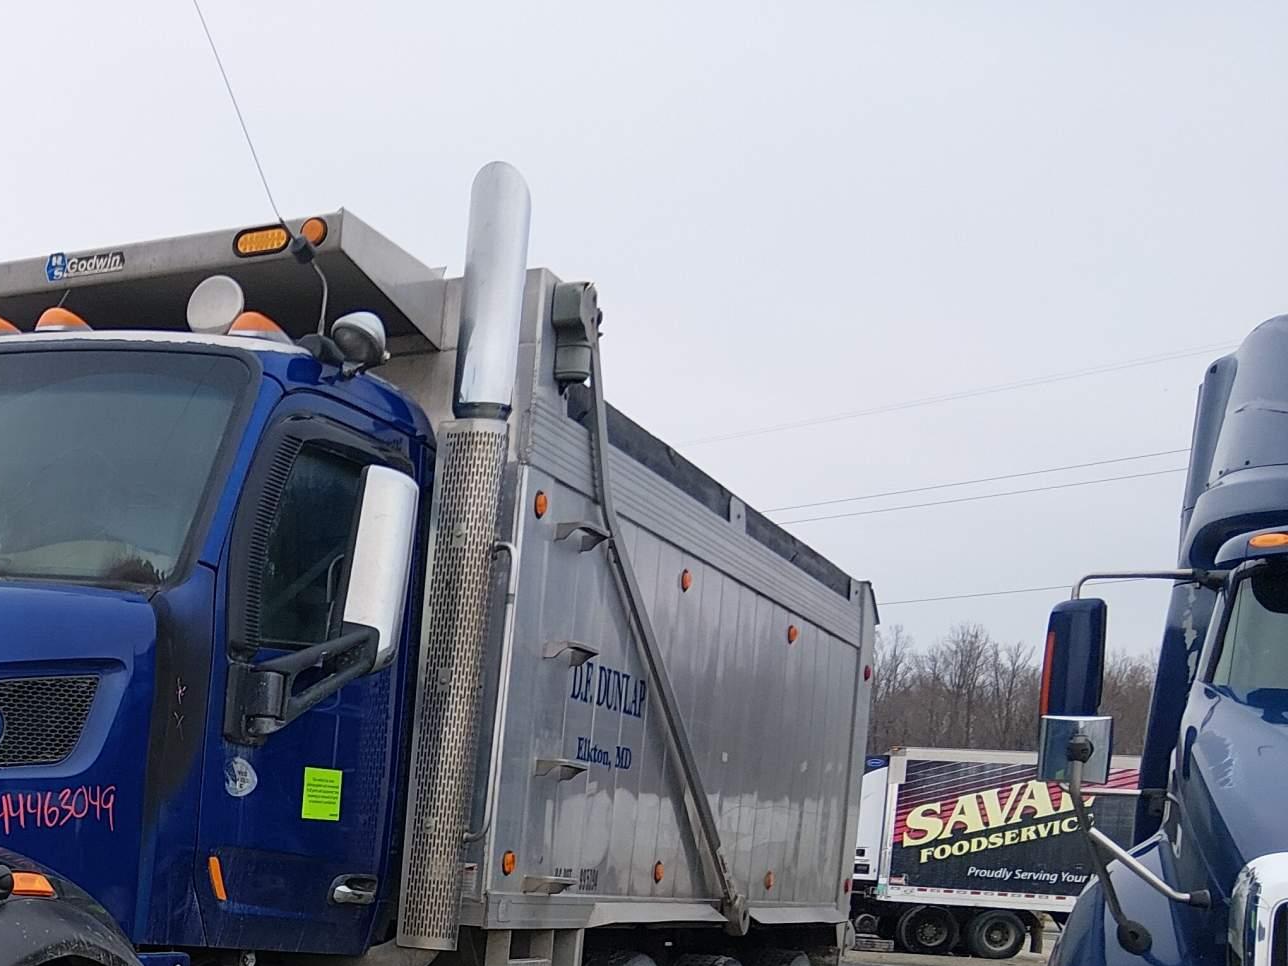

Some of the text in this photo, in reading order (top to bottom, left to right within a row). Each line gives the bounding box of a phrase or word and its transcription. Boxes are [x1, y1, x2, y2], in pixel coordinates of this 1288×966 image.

[67, 252, 121, 273] Godwin
[596, 665, 646, 718] DUNLAP
[576, 737, 632, 771] Elkton, MD
[967, 866, 1013, 881] Proudly
[1014, 869, 1059, 884] Serving
[1061, 871, 1088, 884] Your
